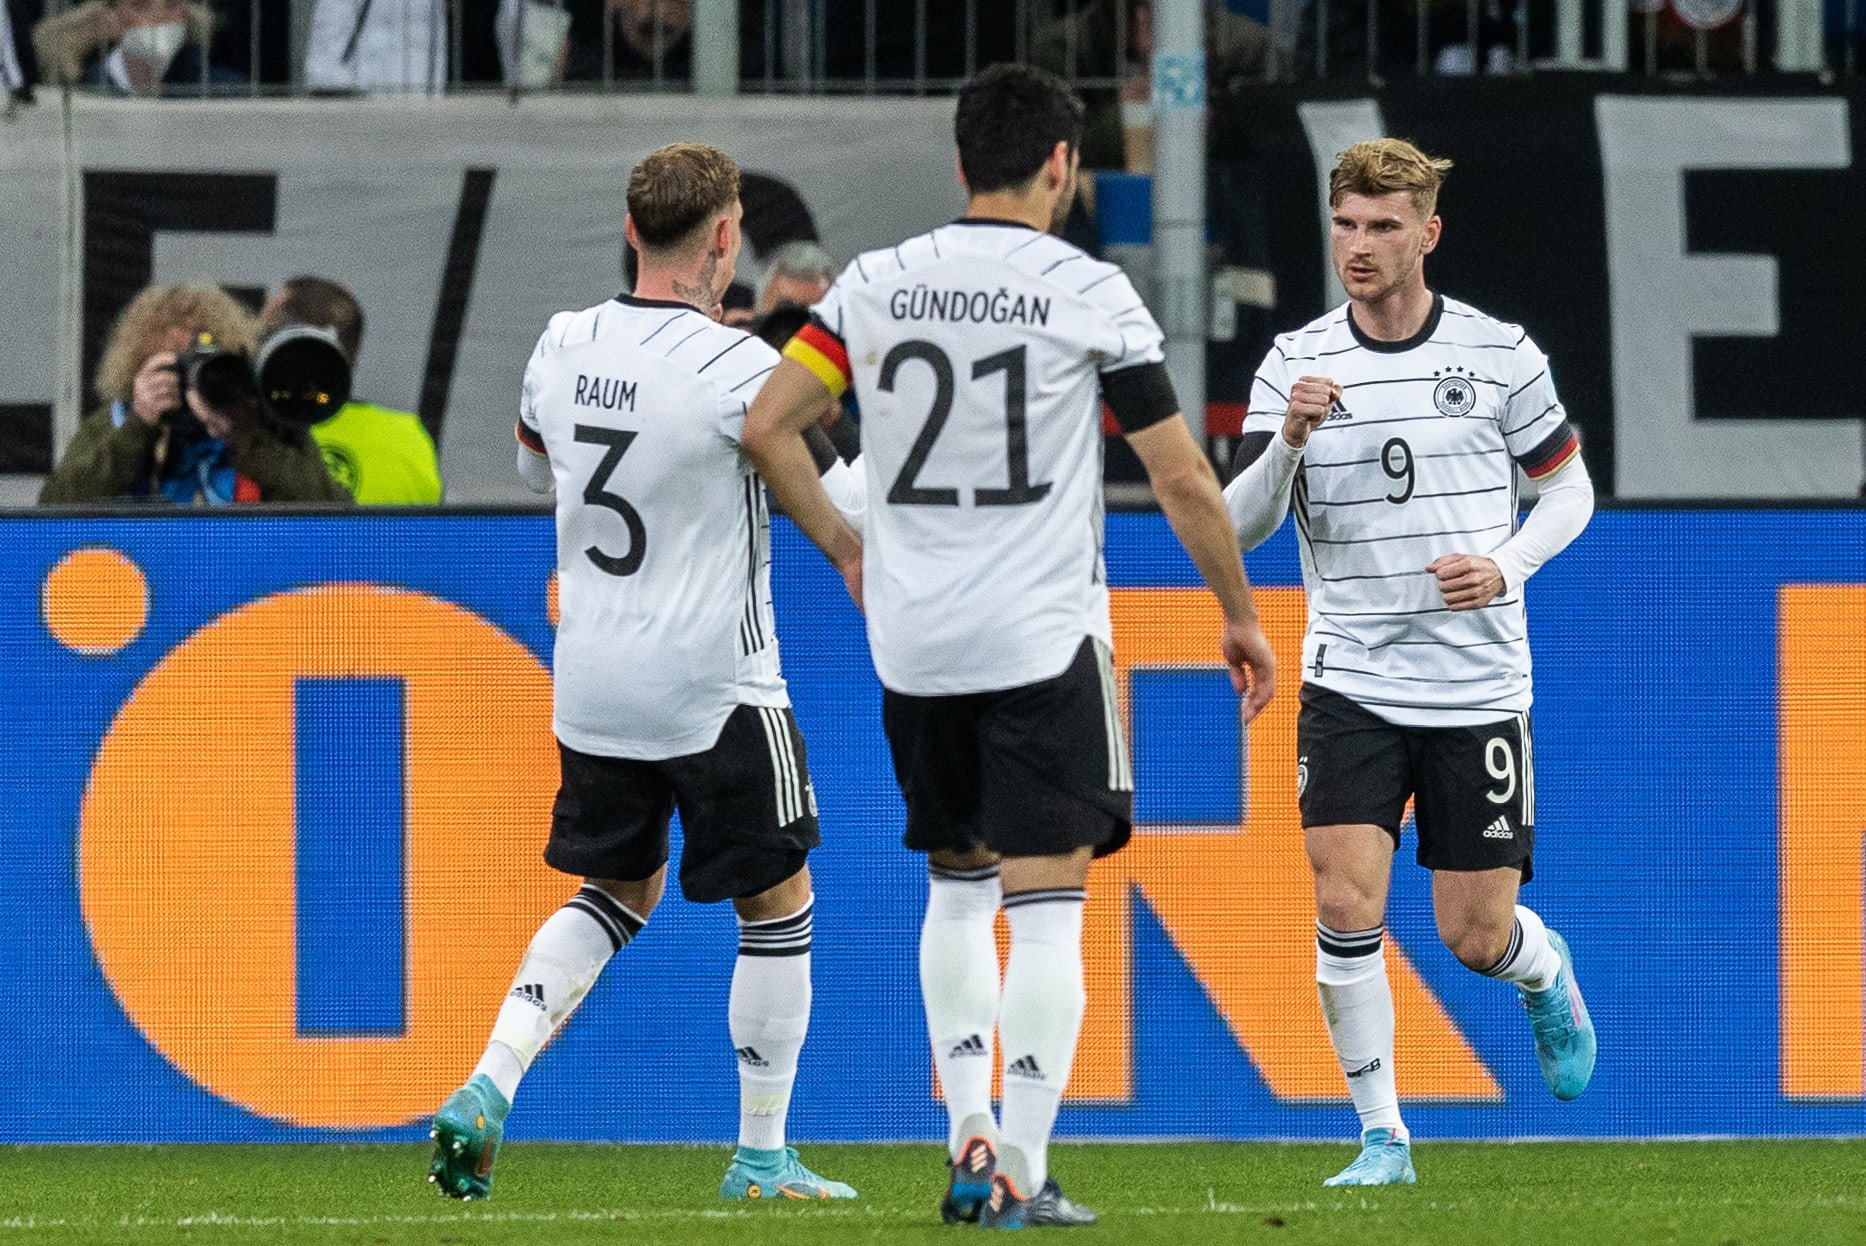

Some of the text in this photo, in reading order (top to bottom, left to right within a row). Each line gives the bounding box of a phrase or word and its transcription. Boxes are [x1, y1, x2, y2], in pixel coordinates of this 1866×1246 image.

[890, 284, 1051, 327] GÜNDOĞAN
[574, 374, 637, 412] RAUM
[877, 338, 1053, 507] 21
[573, 423, 646, 577] 3
[1380, 437, 1416, 504] 9
[1485, 737, 1516, 804] 9
[1482, 828, 1514, 840] adidas
